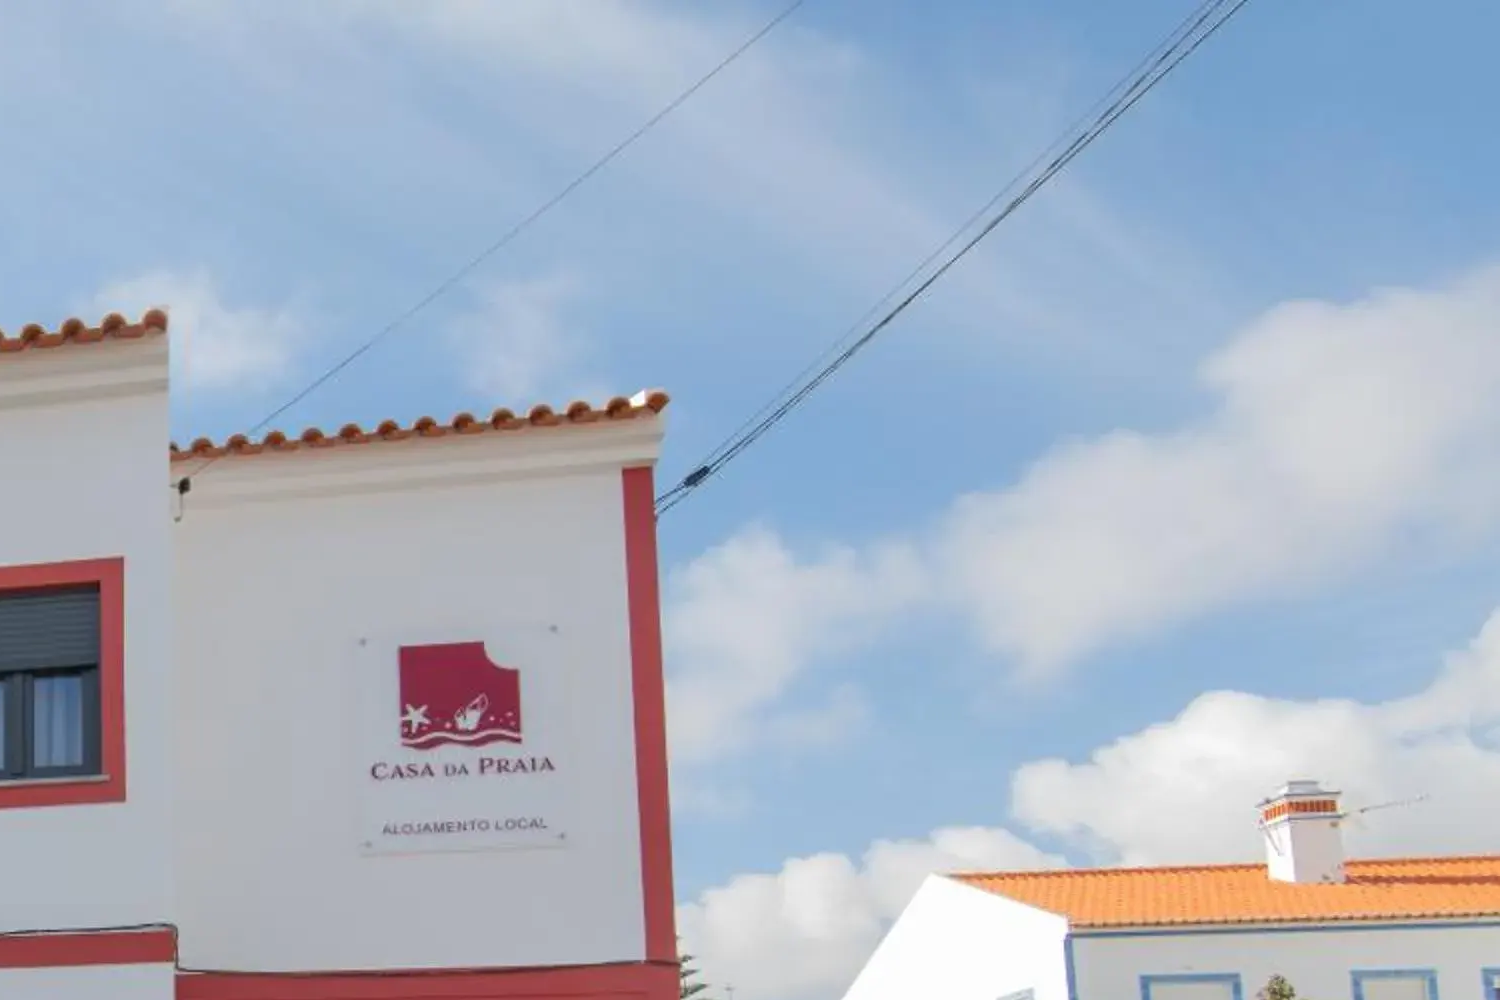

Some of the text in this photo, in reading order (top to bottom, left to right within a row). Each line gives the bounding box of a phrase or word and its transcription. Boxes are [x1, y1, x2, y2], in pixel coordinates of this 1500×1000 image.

[371, 757, 556, 780] CASA DA PRAIA
[382, 817, 548, 835] ALOJAMENTO LOCAL
